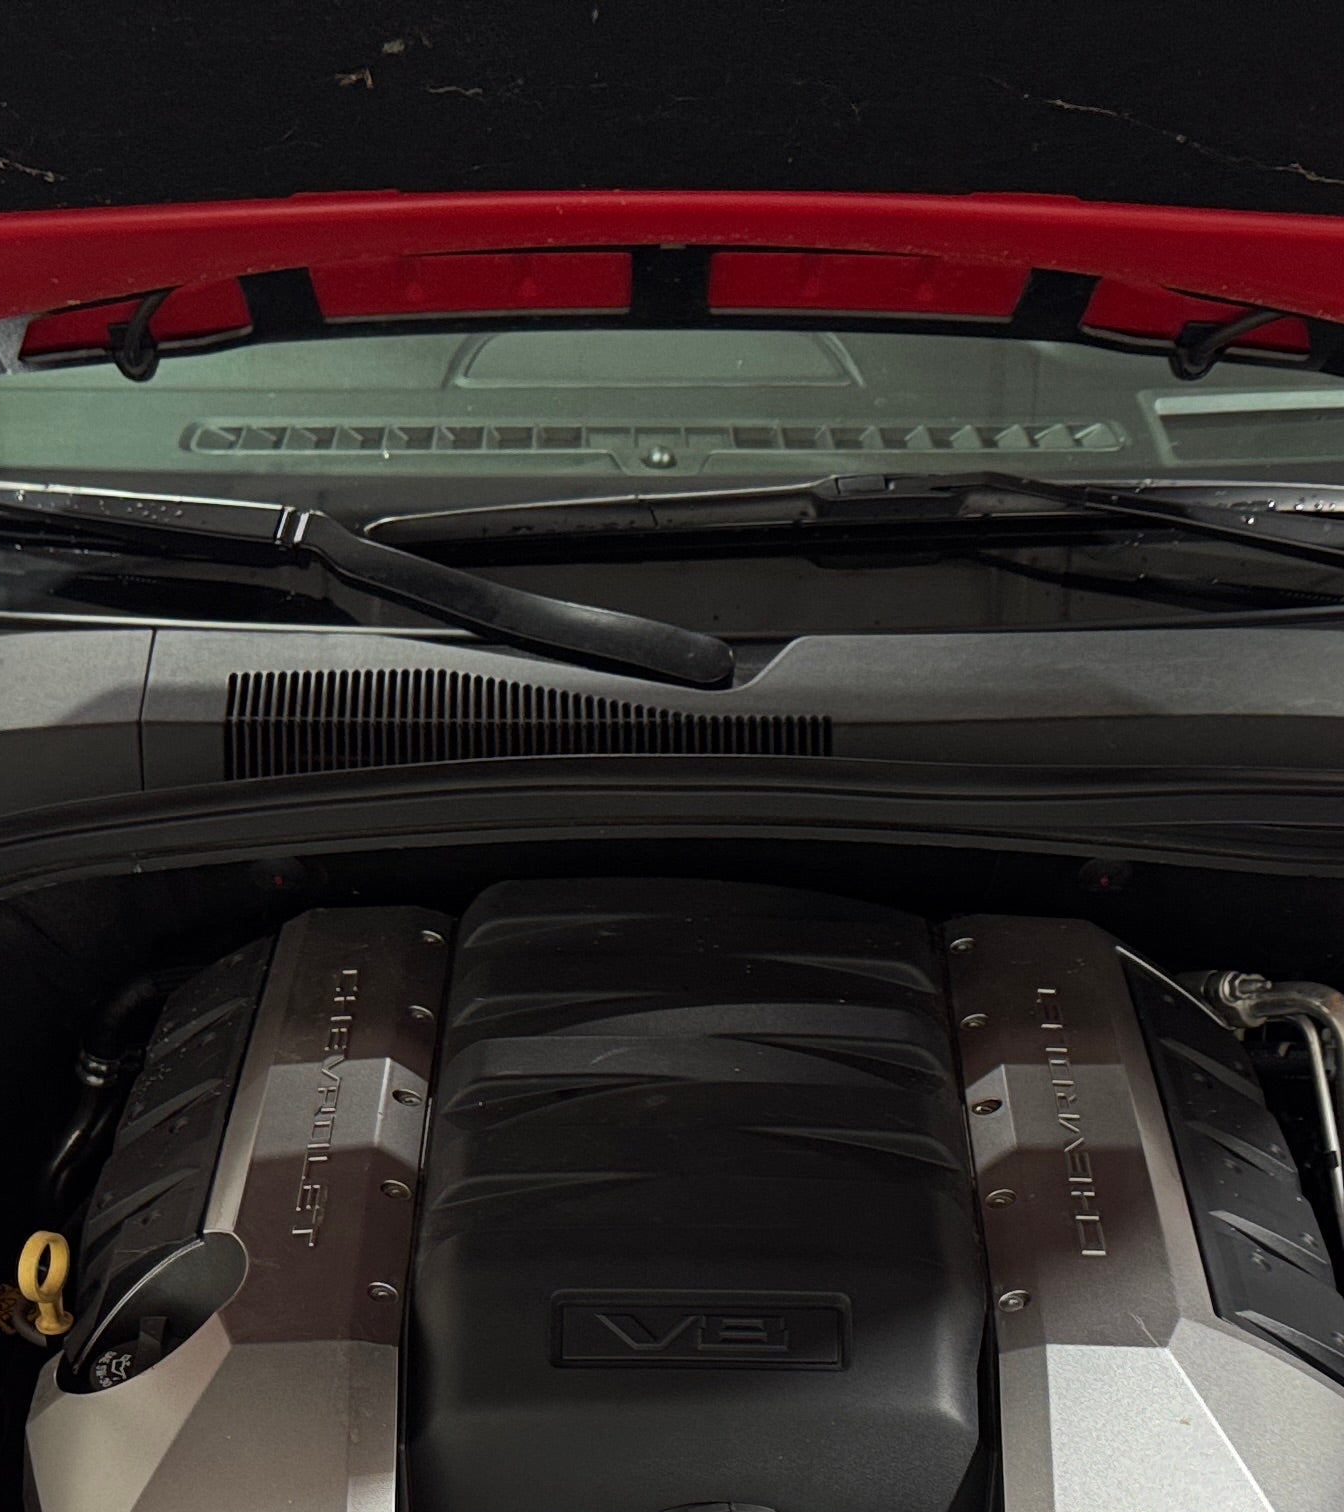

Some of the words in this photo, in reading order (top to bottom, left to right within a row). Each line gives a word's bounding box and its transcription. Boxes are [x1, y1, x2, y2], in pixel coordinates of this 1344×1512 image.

[291, 969, 358, 1248] CHEVROLET
[1036, 988, 1107, 1255] CHEVROLET
[592, 1312, 789, 1352] V8
